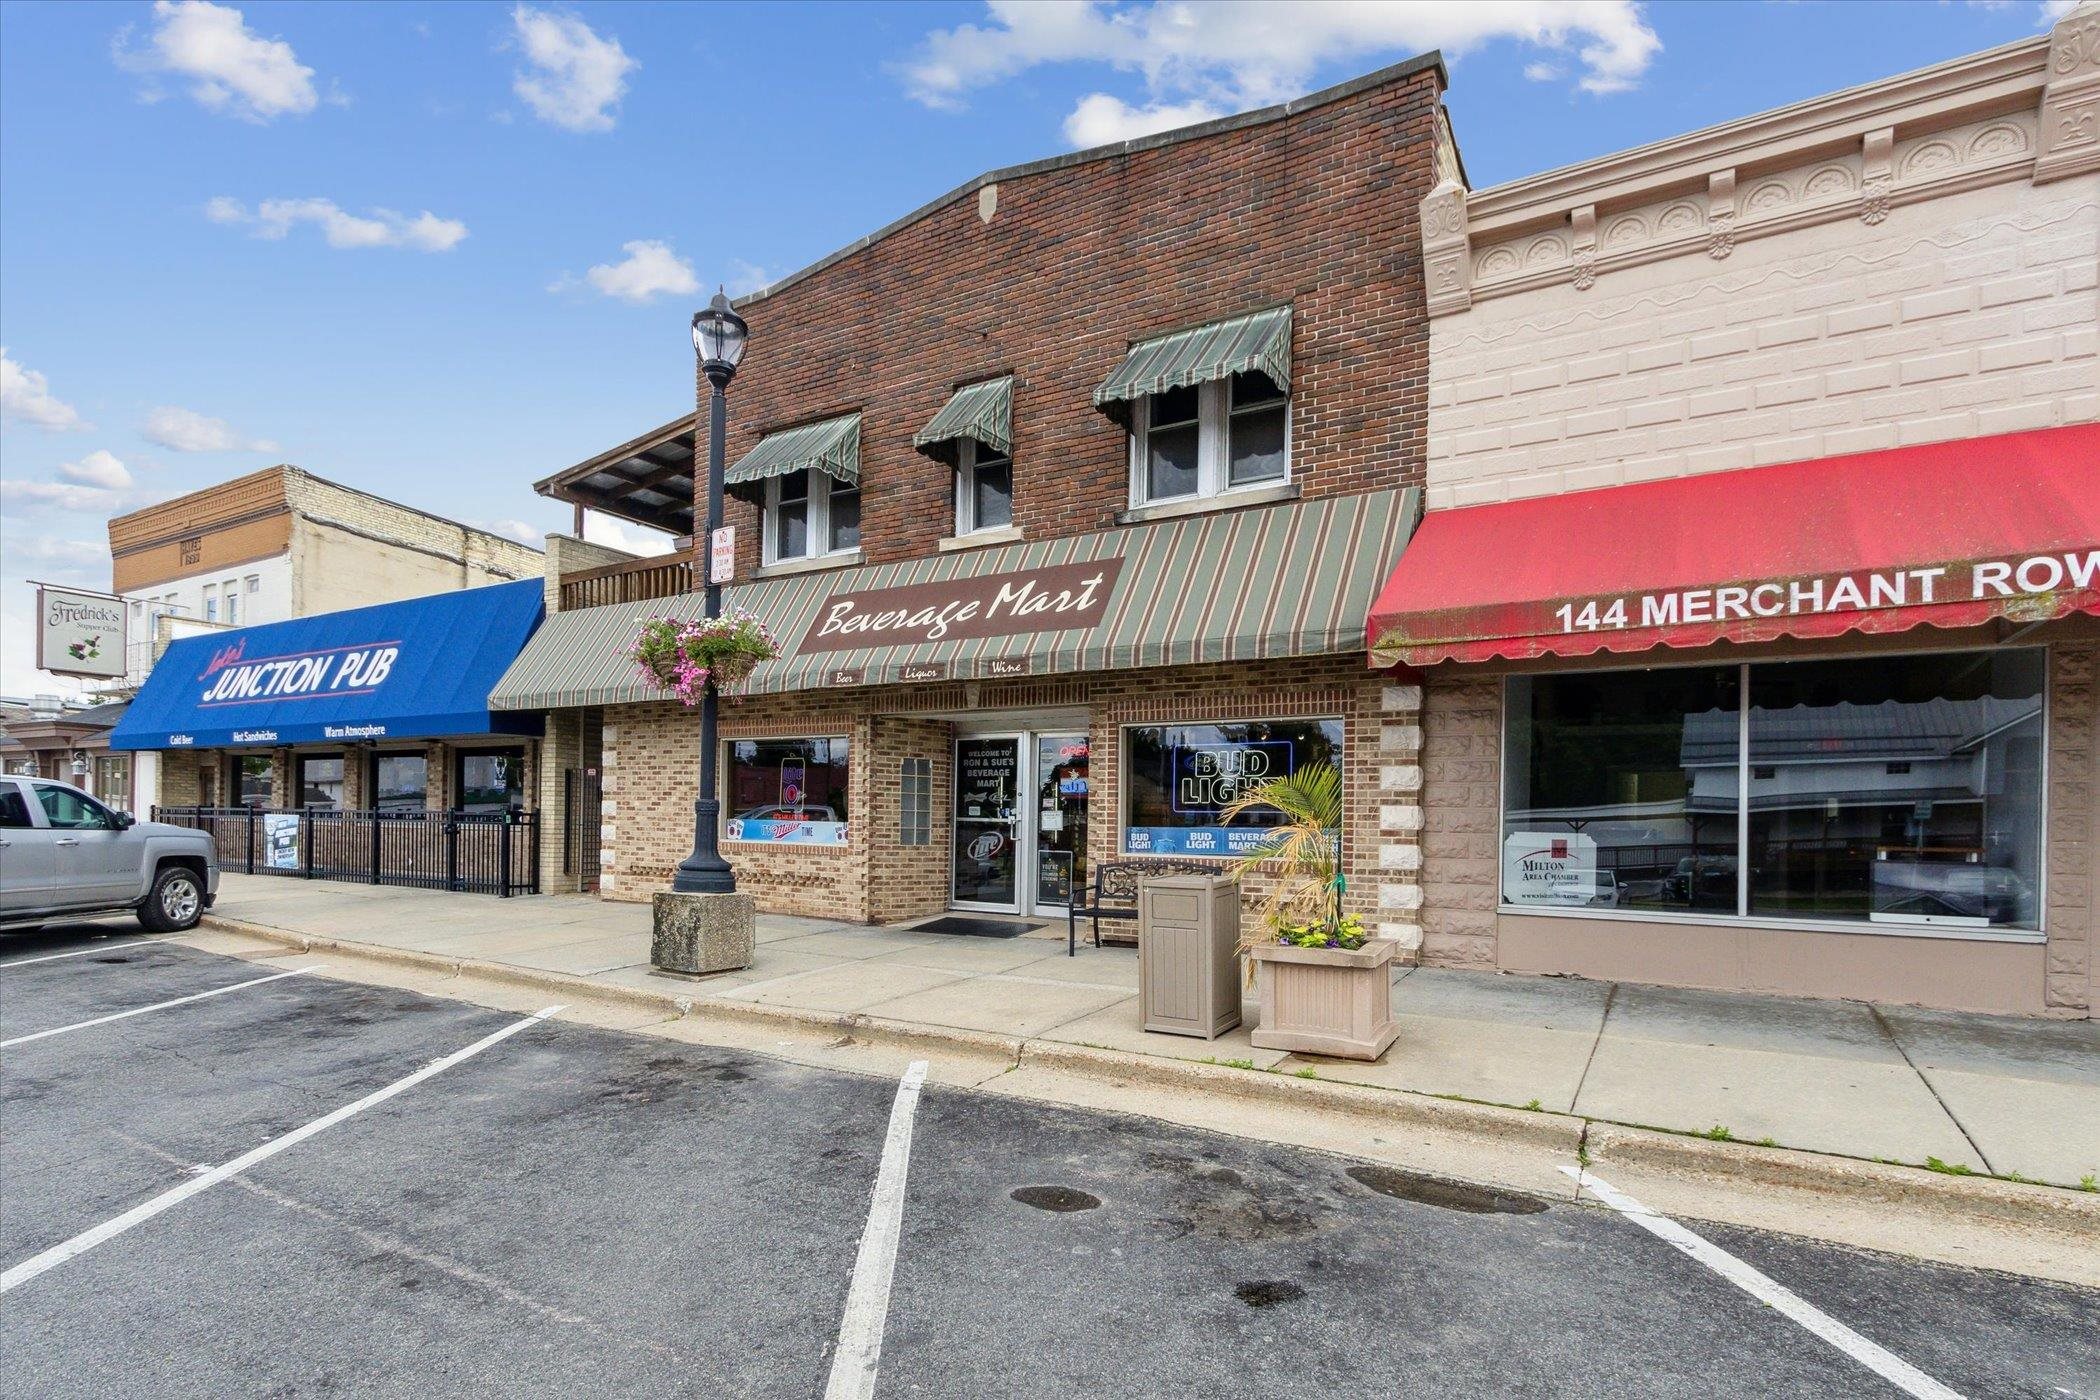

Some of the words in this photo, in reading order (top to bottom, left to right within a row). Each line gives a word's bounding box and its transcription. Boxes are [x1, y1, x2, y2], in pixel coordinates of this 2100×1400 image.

[719, 534, 728, 544] NO
[713, 545, 733, 558] PARKING
[1556, 599, 1628, 633] 144
[1641, 567, 1945, 626] MERCHANT
[1972, 550, 2100, 598] ROW
[817, 600, 981, 639] Beverage
[986, 572, 1105, 619] Mart
[49, 600, 119, 626] Fredrick's
[77, 623, 100, 632] Supper
[103, 625, 119, 633] Club
[905, 665, 938, 679] Liquor
[992, 661, 1021, 673] Wine
[203, 655, 334, 701] JUNCTION
[330, 648, 398, 689] PUB
[836, 672, 853, 683] Beer
[233, 732, 244, 742] Hot
[244, 731, 277, 742] Sandwiches
[325, 727, 343, 738] Warm
[345, 725, 385, 738] Atmosphere
[170, 735, 181, 745] Cold
[181, 735, 193, 745] Beer
[983, 758, 989, 766] &
[991, 758, 1014, 766] SUE'S
[1195, 750, 1270, 778] BUD
[967, 769, 1011, 777] BEVERAGE
[772, 823, 802, 838] Miller
[801, 827, 813, 837] TIME
[1131, 833, 1149, 841] BUD
[1190, 833, 1212, 841] BUD
[1129, 841, 1151, 849] LIGHT
[1186, 840, 1215, 849] LIGHT
[1228, 842, 1257, 850] MART
[1522, 860, 1564, 871] MILTON
[1522, 872, 1542, 881] AREA
[1545, 872, 1579, 881] CHAMBER
